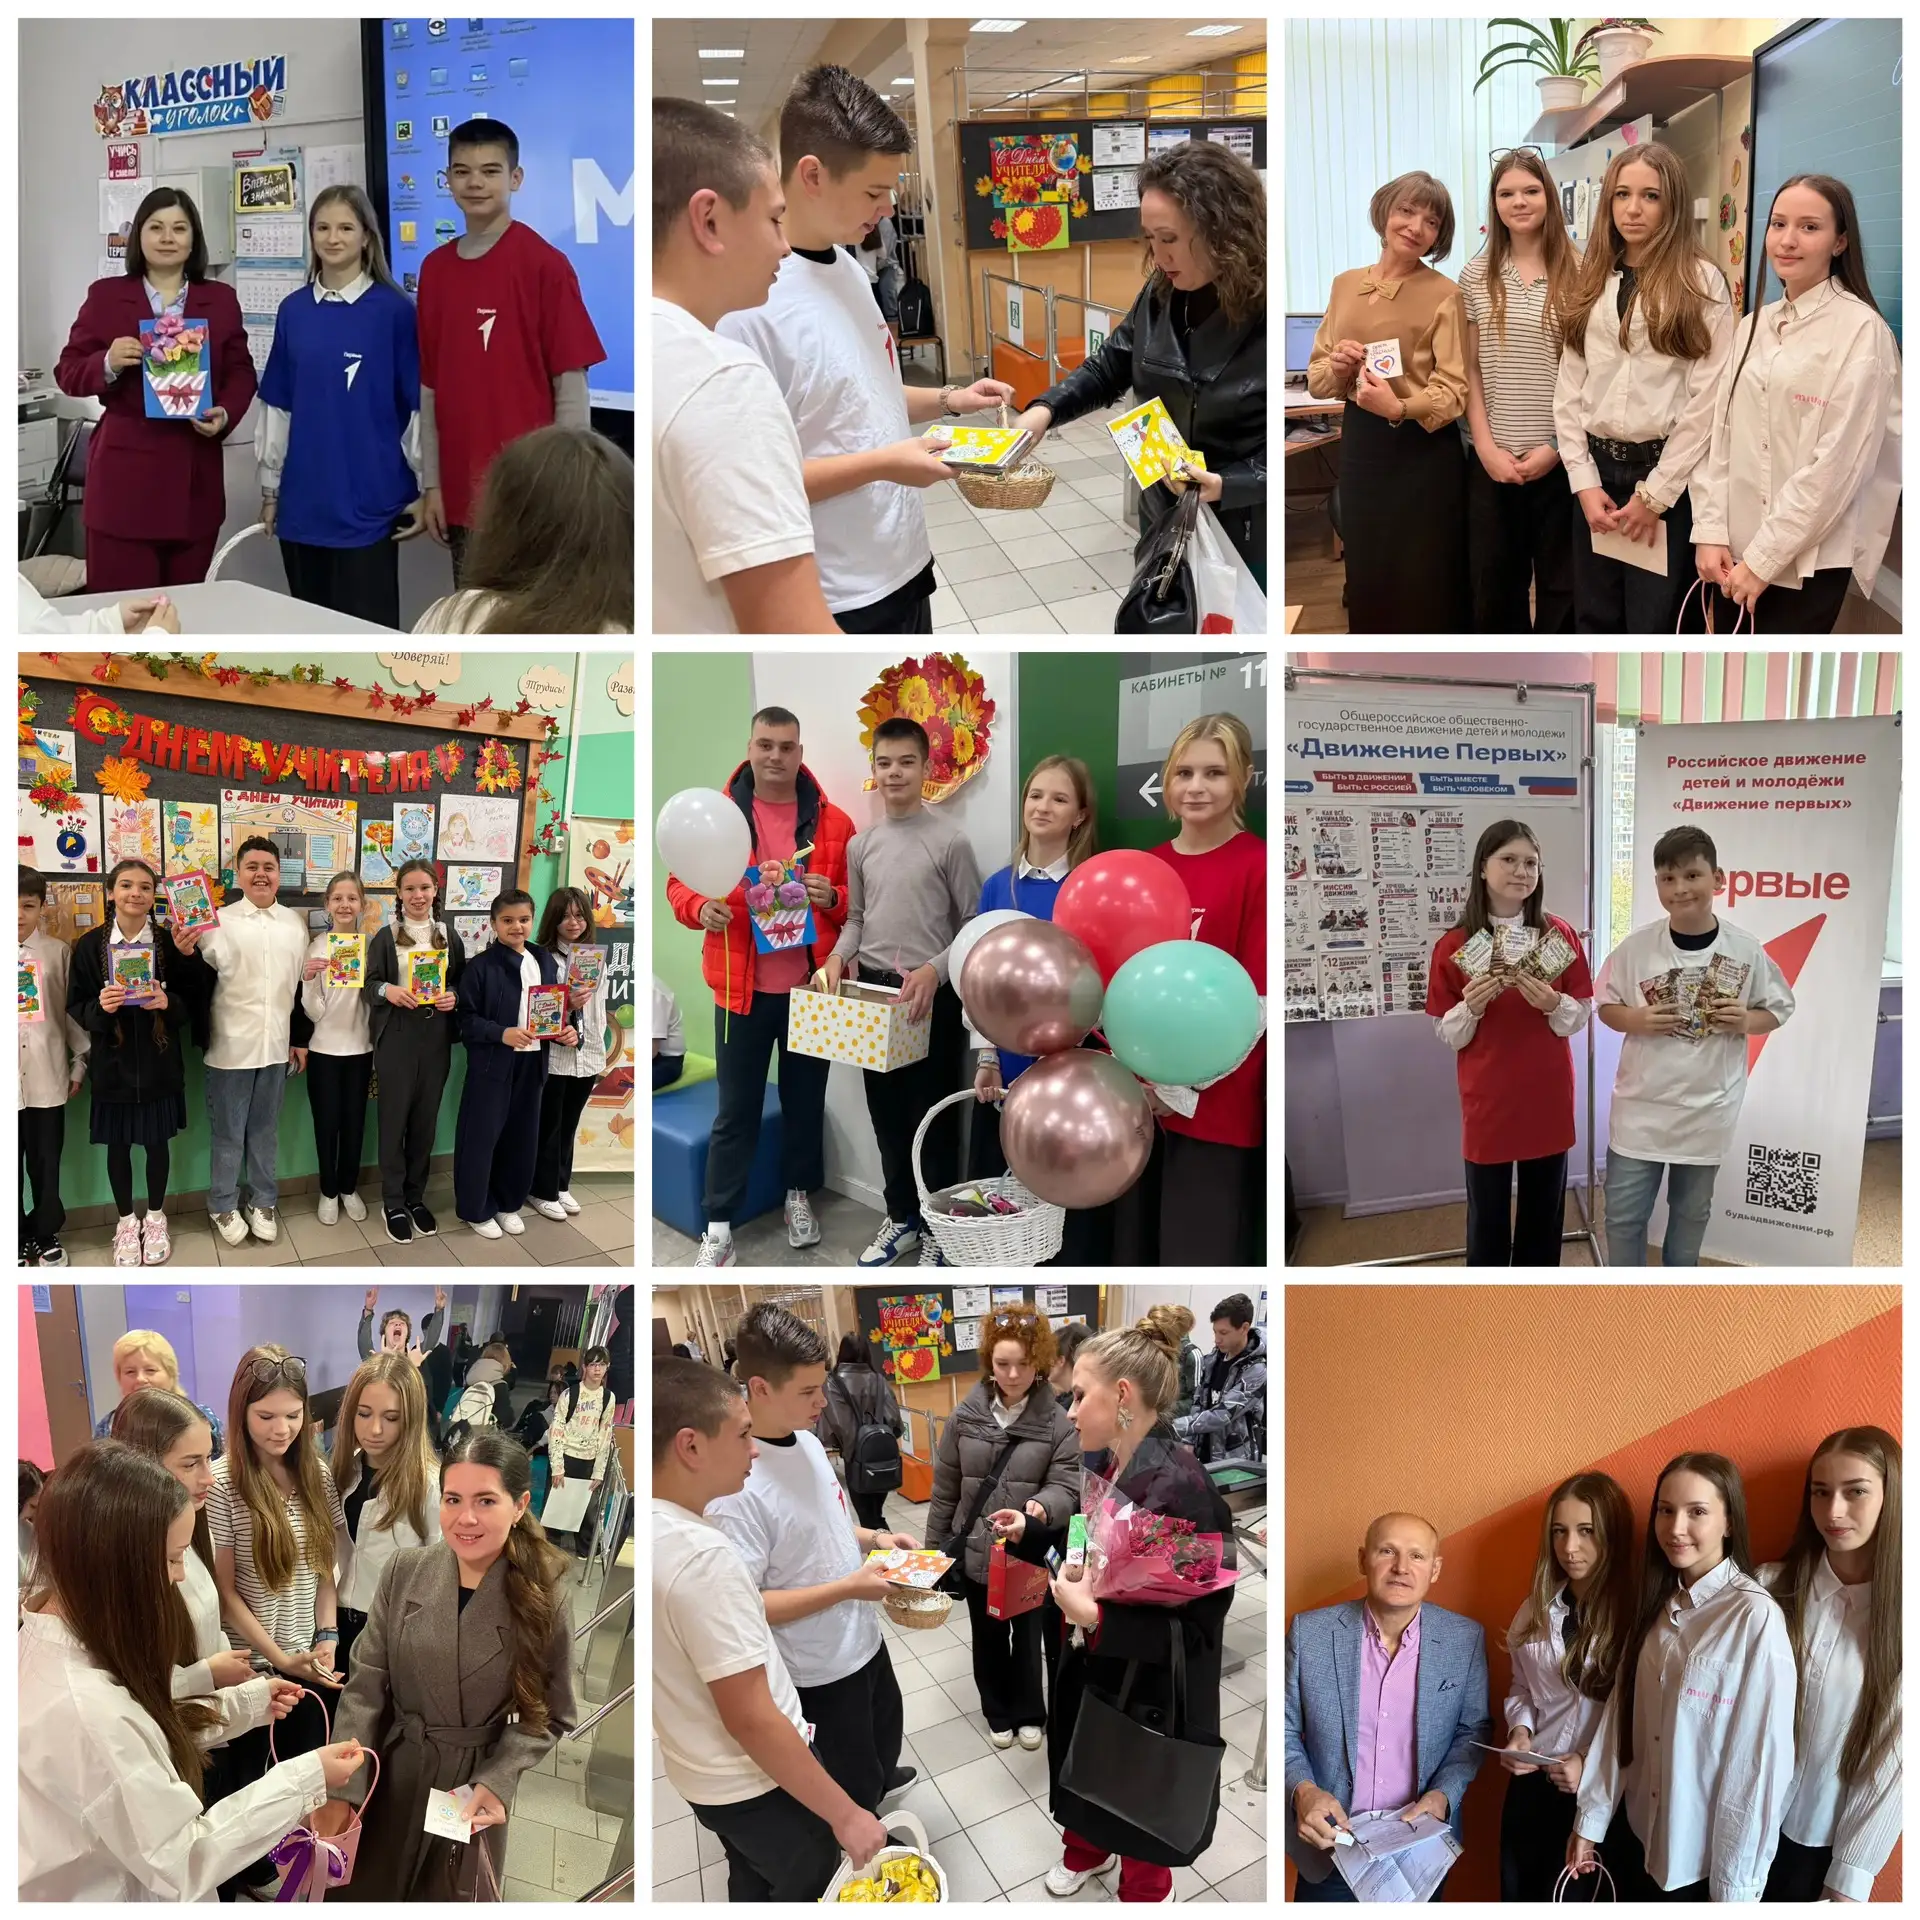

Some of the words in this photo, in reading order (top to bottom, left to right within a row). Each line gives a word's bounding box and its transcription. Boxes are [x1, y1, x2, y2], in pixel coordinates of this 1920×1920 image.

[124, 55, 286, 110] КЛАССНЫЙ
[165, 102, 234, 130] УГОЛОК
[995, 147, 1010, 166] С
[995, 163, 1050, 178] УЧИТЕЛЯ!
[250, 183, 287, 203] ЗНАНИЯМ!
[391, 652, 450, 668] Доверяй!
[525, 679, 566, 695] Трудись!
[610, 681, 634, 693] Разв
[1131, 670, 1206, 694] КАБИНЕТЫ
[1209, 666, 1227, 680] №
[74, 695, 120, 745] С
[1339, 709, 1446, 724] Общероссийское
[1448, 715, 1529, 728] общественно-
[1297, 719, 1403, 735] государственное
[1405, 724, 1463, 736] движение
[1465, 726, 1499, 737] детей
[1501, 728, 1508, 737] и
[1510, 728, 1566, 739] молодежи
[1286, 737, 1450, 760] «Движение
[1456, 743, 1567, 764] Первых»
[1667, 754, 1769, 768] Российское
[1773, 752, 1866, 769] движение
[1321, 772, 1347, 781] БЫТЬ
[1355, 773, 1407, 782] ДВИЖЕНИИ
[1430, 775, 1453, 783] БЫТЬ
[1454, 775, 1488, 783] ВМЕСТЕ
[1682, 775, 1730, 790] детей
[1736, 776, 1746, 788] и
[1751, 774, 1845, 789] молодёжи
[1337, 783, 1361, 791] БЫТЬ
[1370, 782, 1412, 792] РОССИЕЙ
[1432, 785, 1456, 793] БЫТЬ
[1456, 785, 1508, 793] ЧЕЛОВЕКОМ
[224, 790, 233, 801] С
[237, 791, 280, 804] ДНЕМ
[291, 795, 344, 809] УЧИТЕЛЯ!
[1672, 798, 1769, 812] «Движение
[1774, 799, 1852, 812] первых»
[1712, 870, 1851, 908] ервые
[1327, 957, 1338, 967] 12
[1725, 1209, 1834, 1238] будьвдвижении.рф
[882, 1304, 895, 1320] С
[883, 1316, 923, 1328] УЧИТЕЛЯ!
